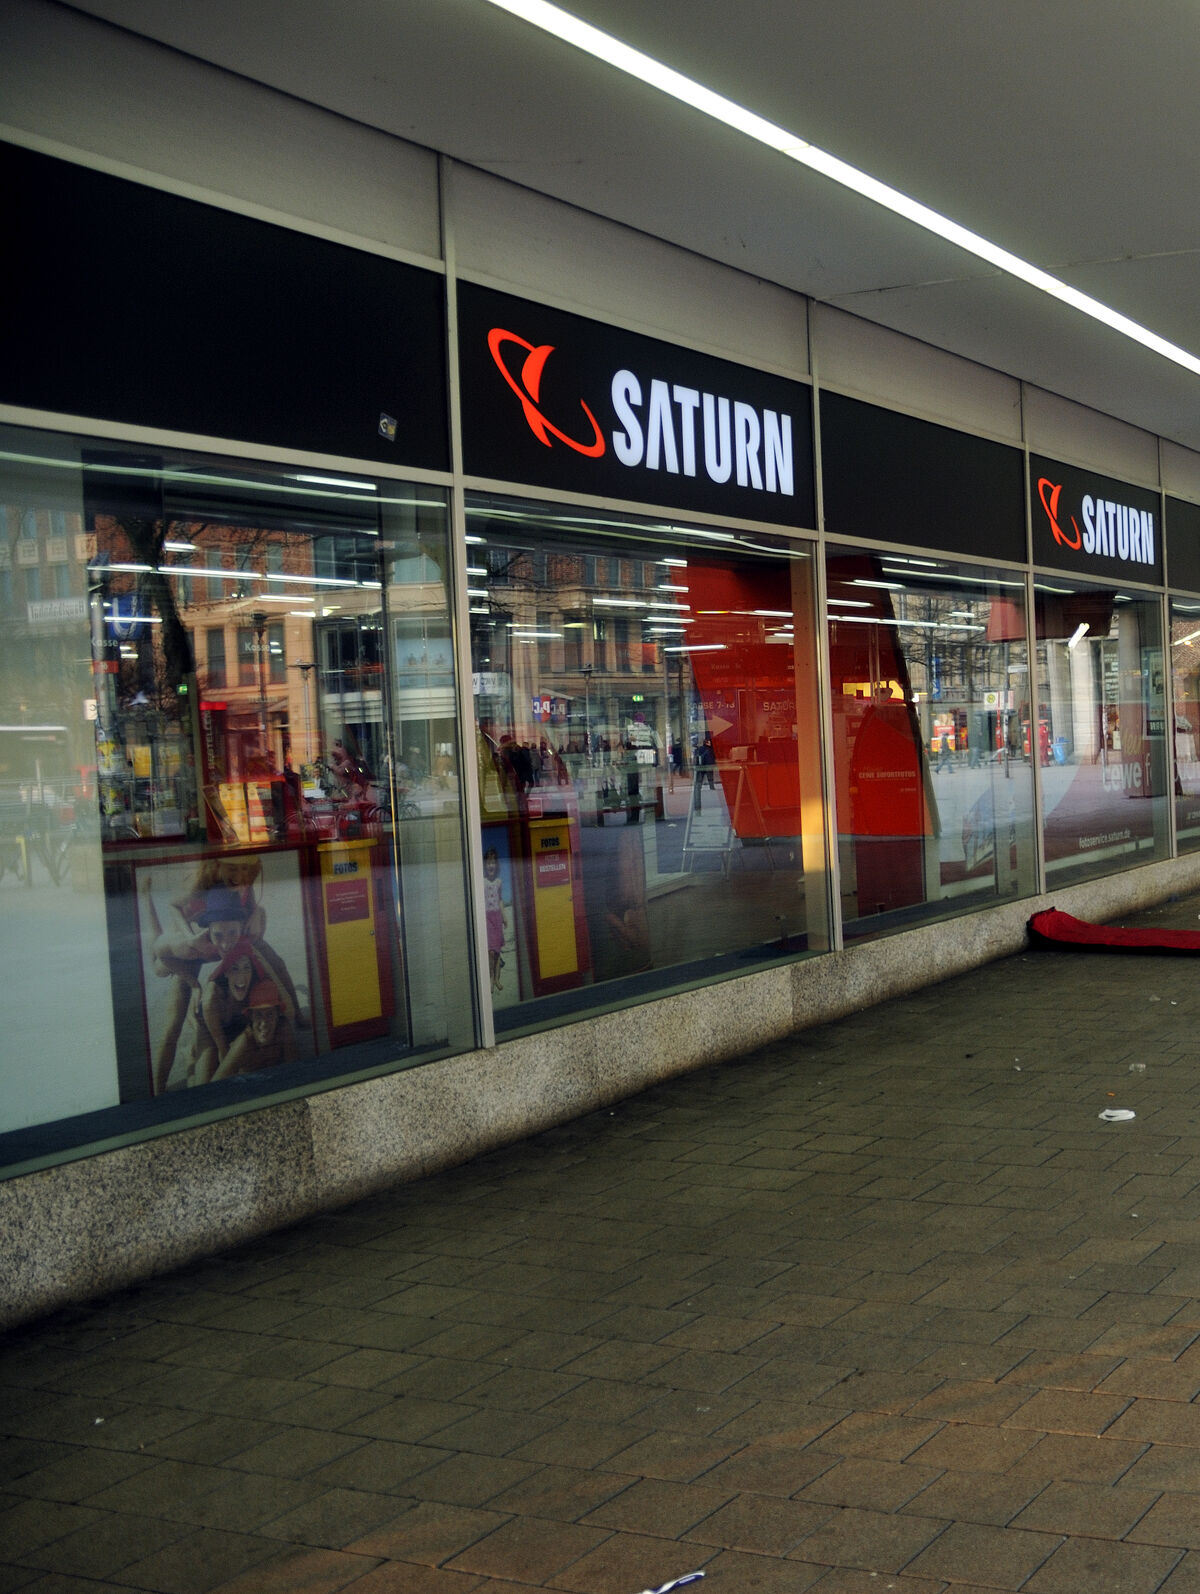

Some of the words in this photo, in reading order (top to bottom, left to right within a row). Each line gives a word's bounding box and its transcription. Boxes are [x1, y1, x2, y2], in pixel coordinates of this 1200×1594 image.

[611, 369, 794, 496] SATURN
[1082, 494, 1155, 565] SATURN
[762, 701, 796, 712] SATUR
[334, 861, 358, 875] FOTOS
